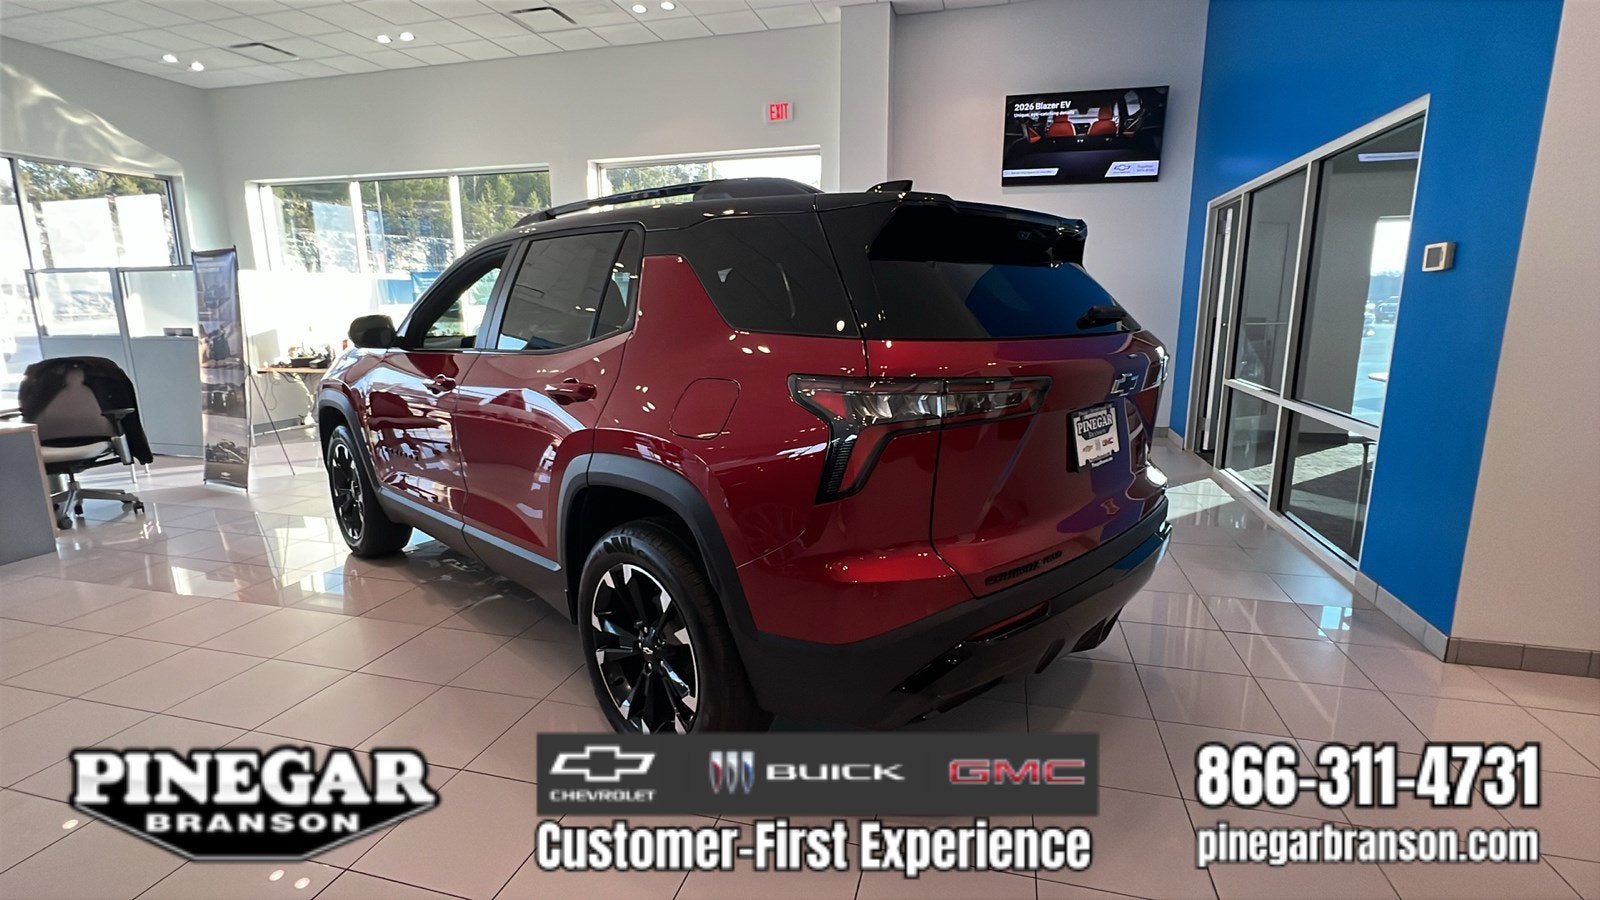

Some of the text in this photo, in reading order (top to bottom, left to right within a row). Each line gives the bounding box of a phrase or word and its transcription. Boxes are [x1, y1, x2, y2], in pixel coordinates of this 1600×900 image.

[769, 102, 789, 121] EXIT
[1013, 100, 1072, 112] 2026 Blazer EV
[1076, 413, 1114, 435] PINEGAR
